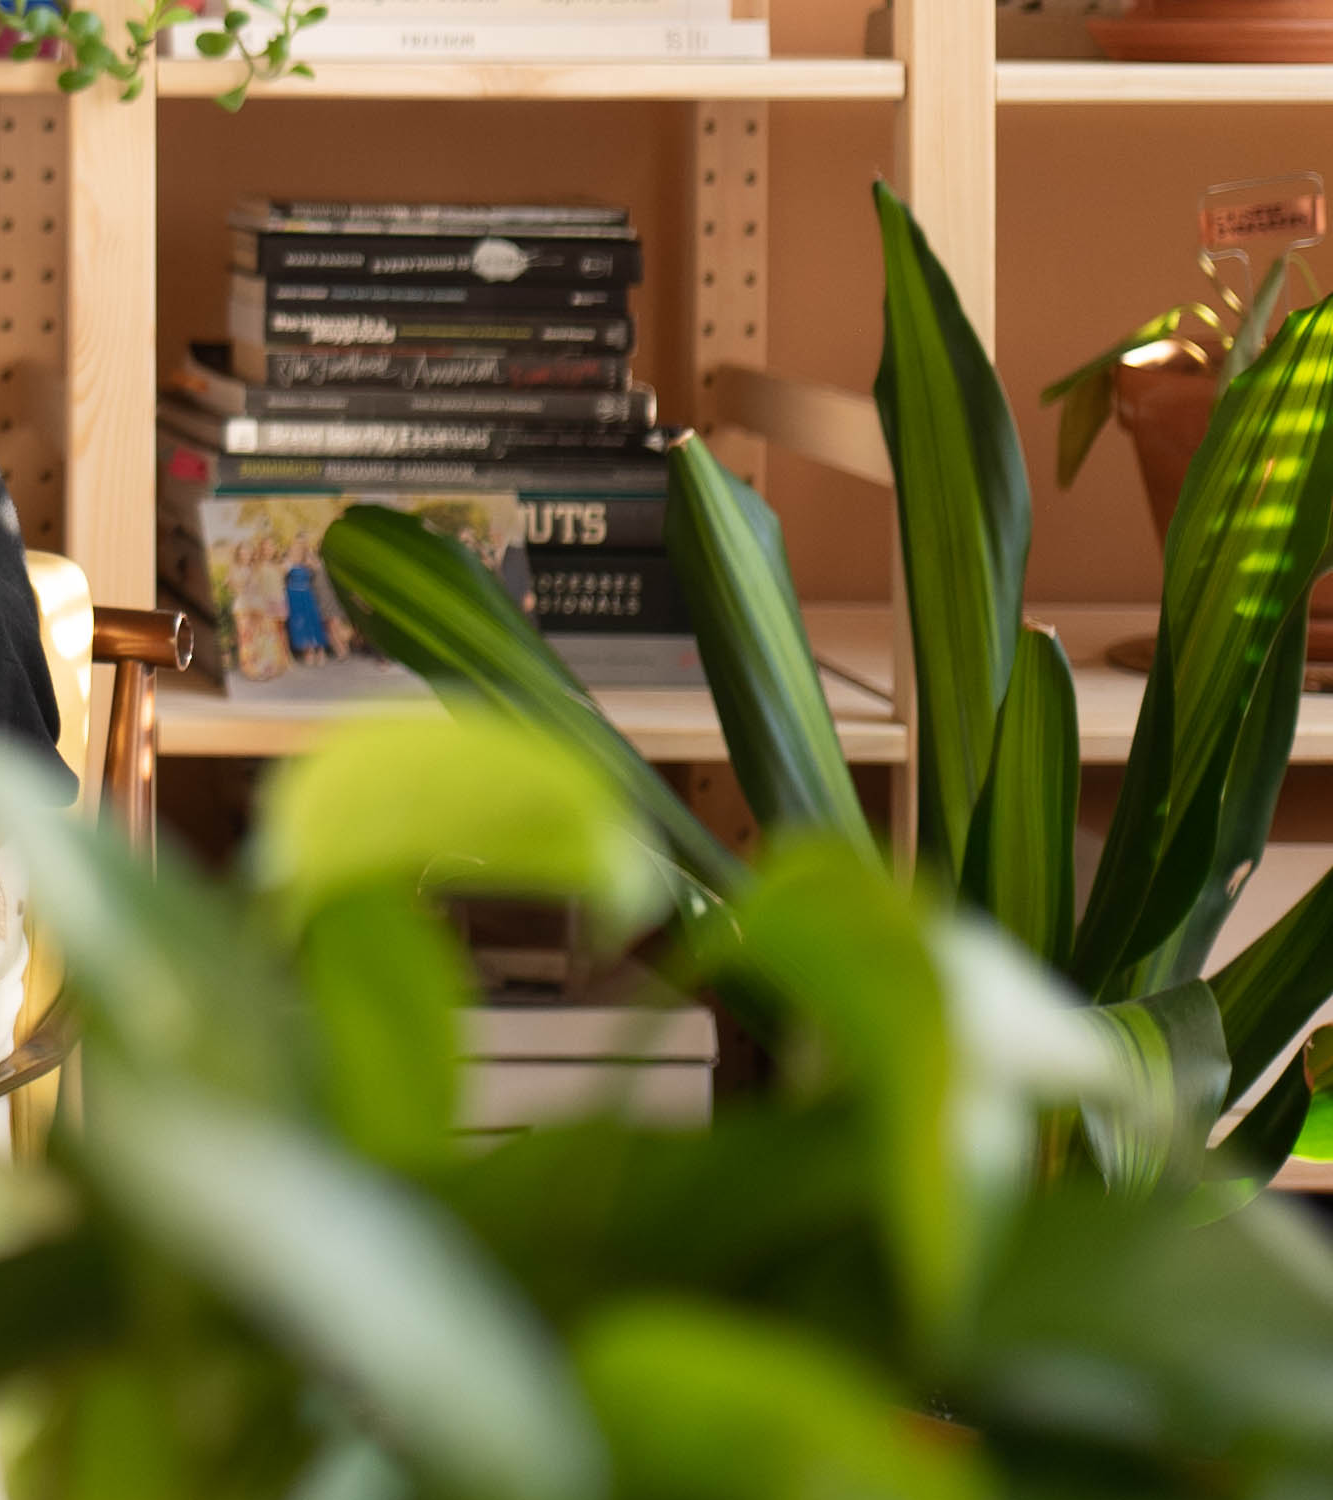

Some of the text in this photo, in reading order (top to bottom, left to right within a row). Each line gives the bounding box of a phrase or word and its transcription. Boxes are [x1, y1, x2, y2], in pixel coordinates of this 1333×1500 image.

[525, 501, 608, 546] UTS
[536, 572, 642, 594] OCESSES
[536, 595, 642, 617] SIONALS
